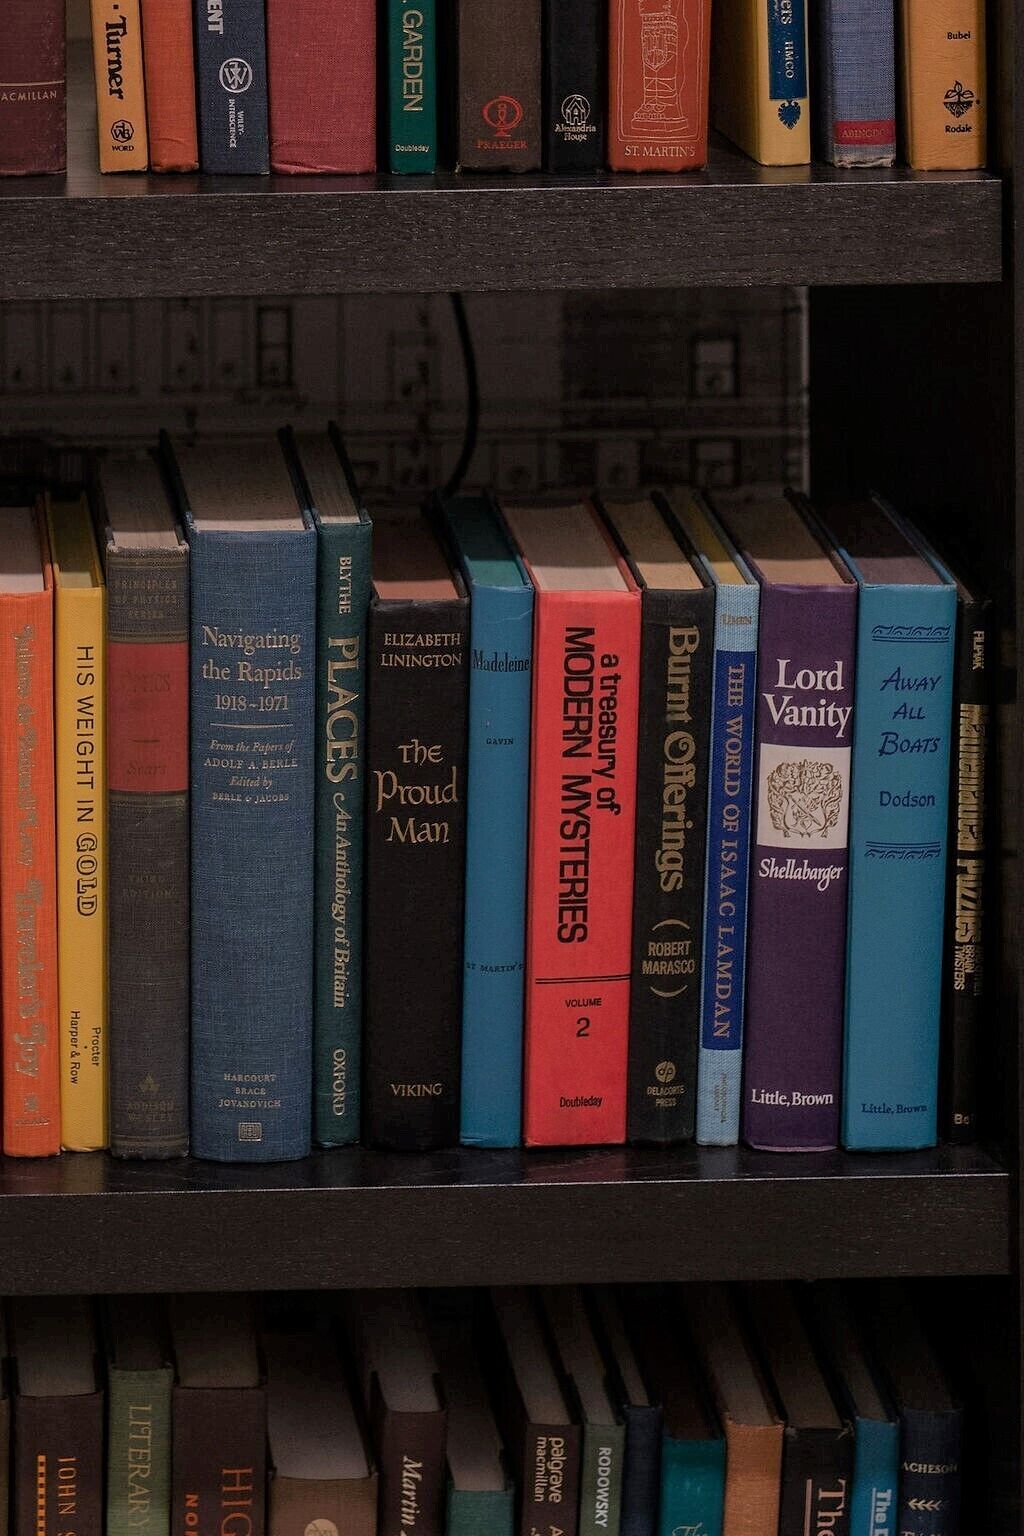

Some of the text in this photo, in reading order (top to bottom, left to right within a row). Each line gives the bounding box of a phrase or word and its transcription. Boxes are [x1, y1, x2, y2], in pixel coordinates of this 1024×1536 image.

[105, 15, 124, 101] Turner
[947, 30, 971, 40] Bubel
[403, 10, 424, 113] GARDEN
[945, 124, 972, 133] Rodale
[202, 628, 301, 655] Navigating
[202, 661, 302, 686] the Rapids
[775, 659, 844, 691] Lord
[326, 636, 360, 783] PLACES
[764, 693, 851, 740] Vanity
[595, 654, 621, 816] a treasury of
[76, 646, 98, 917] HIS WEIGHT IN GOLD
[655, 626, 700, 892] Burnt Offerings
[377, 767, 458, 812] Proud
[558, 627, 595, 945] MODERN MYSTERIES
[385, 816, 450, 844] Man
[759, 858, 843, 891] Shellabarger
[565, 998, 602, 1008] VOLUME
[576, 1017, 590, 1037] 2
[391, 1082, 442, 1097] VIKING
[560, 1095, 602, 1108] Doubleday
[127, 1404, 150, 1529] LITERARY
[534, 1437, 545, 1502] macmillan
[545, 1438, 565, 1502] palgrave
[594, 1447, 611, 1527] RODOWSKY
